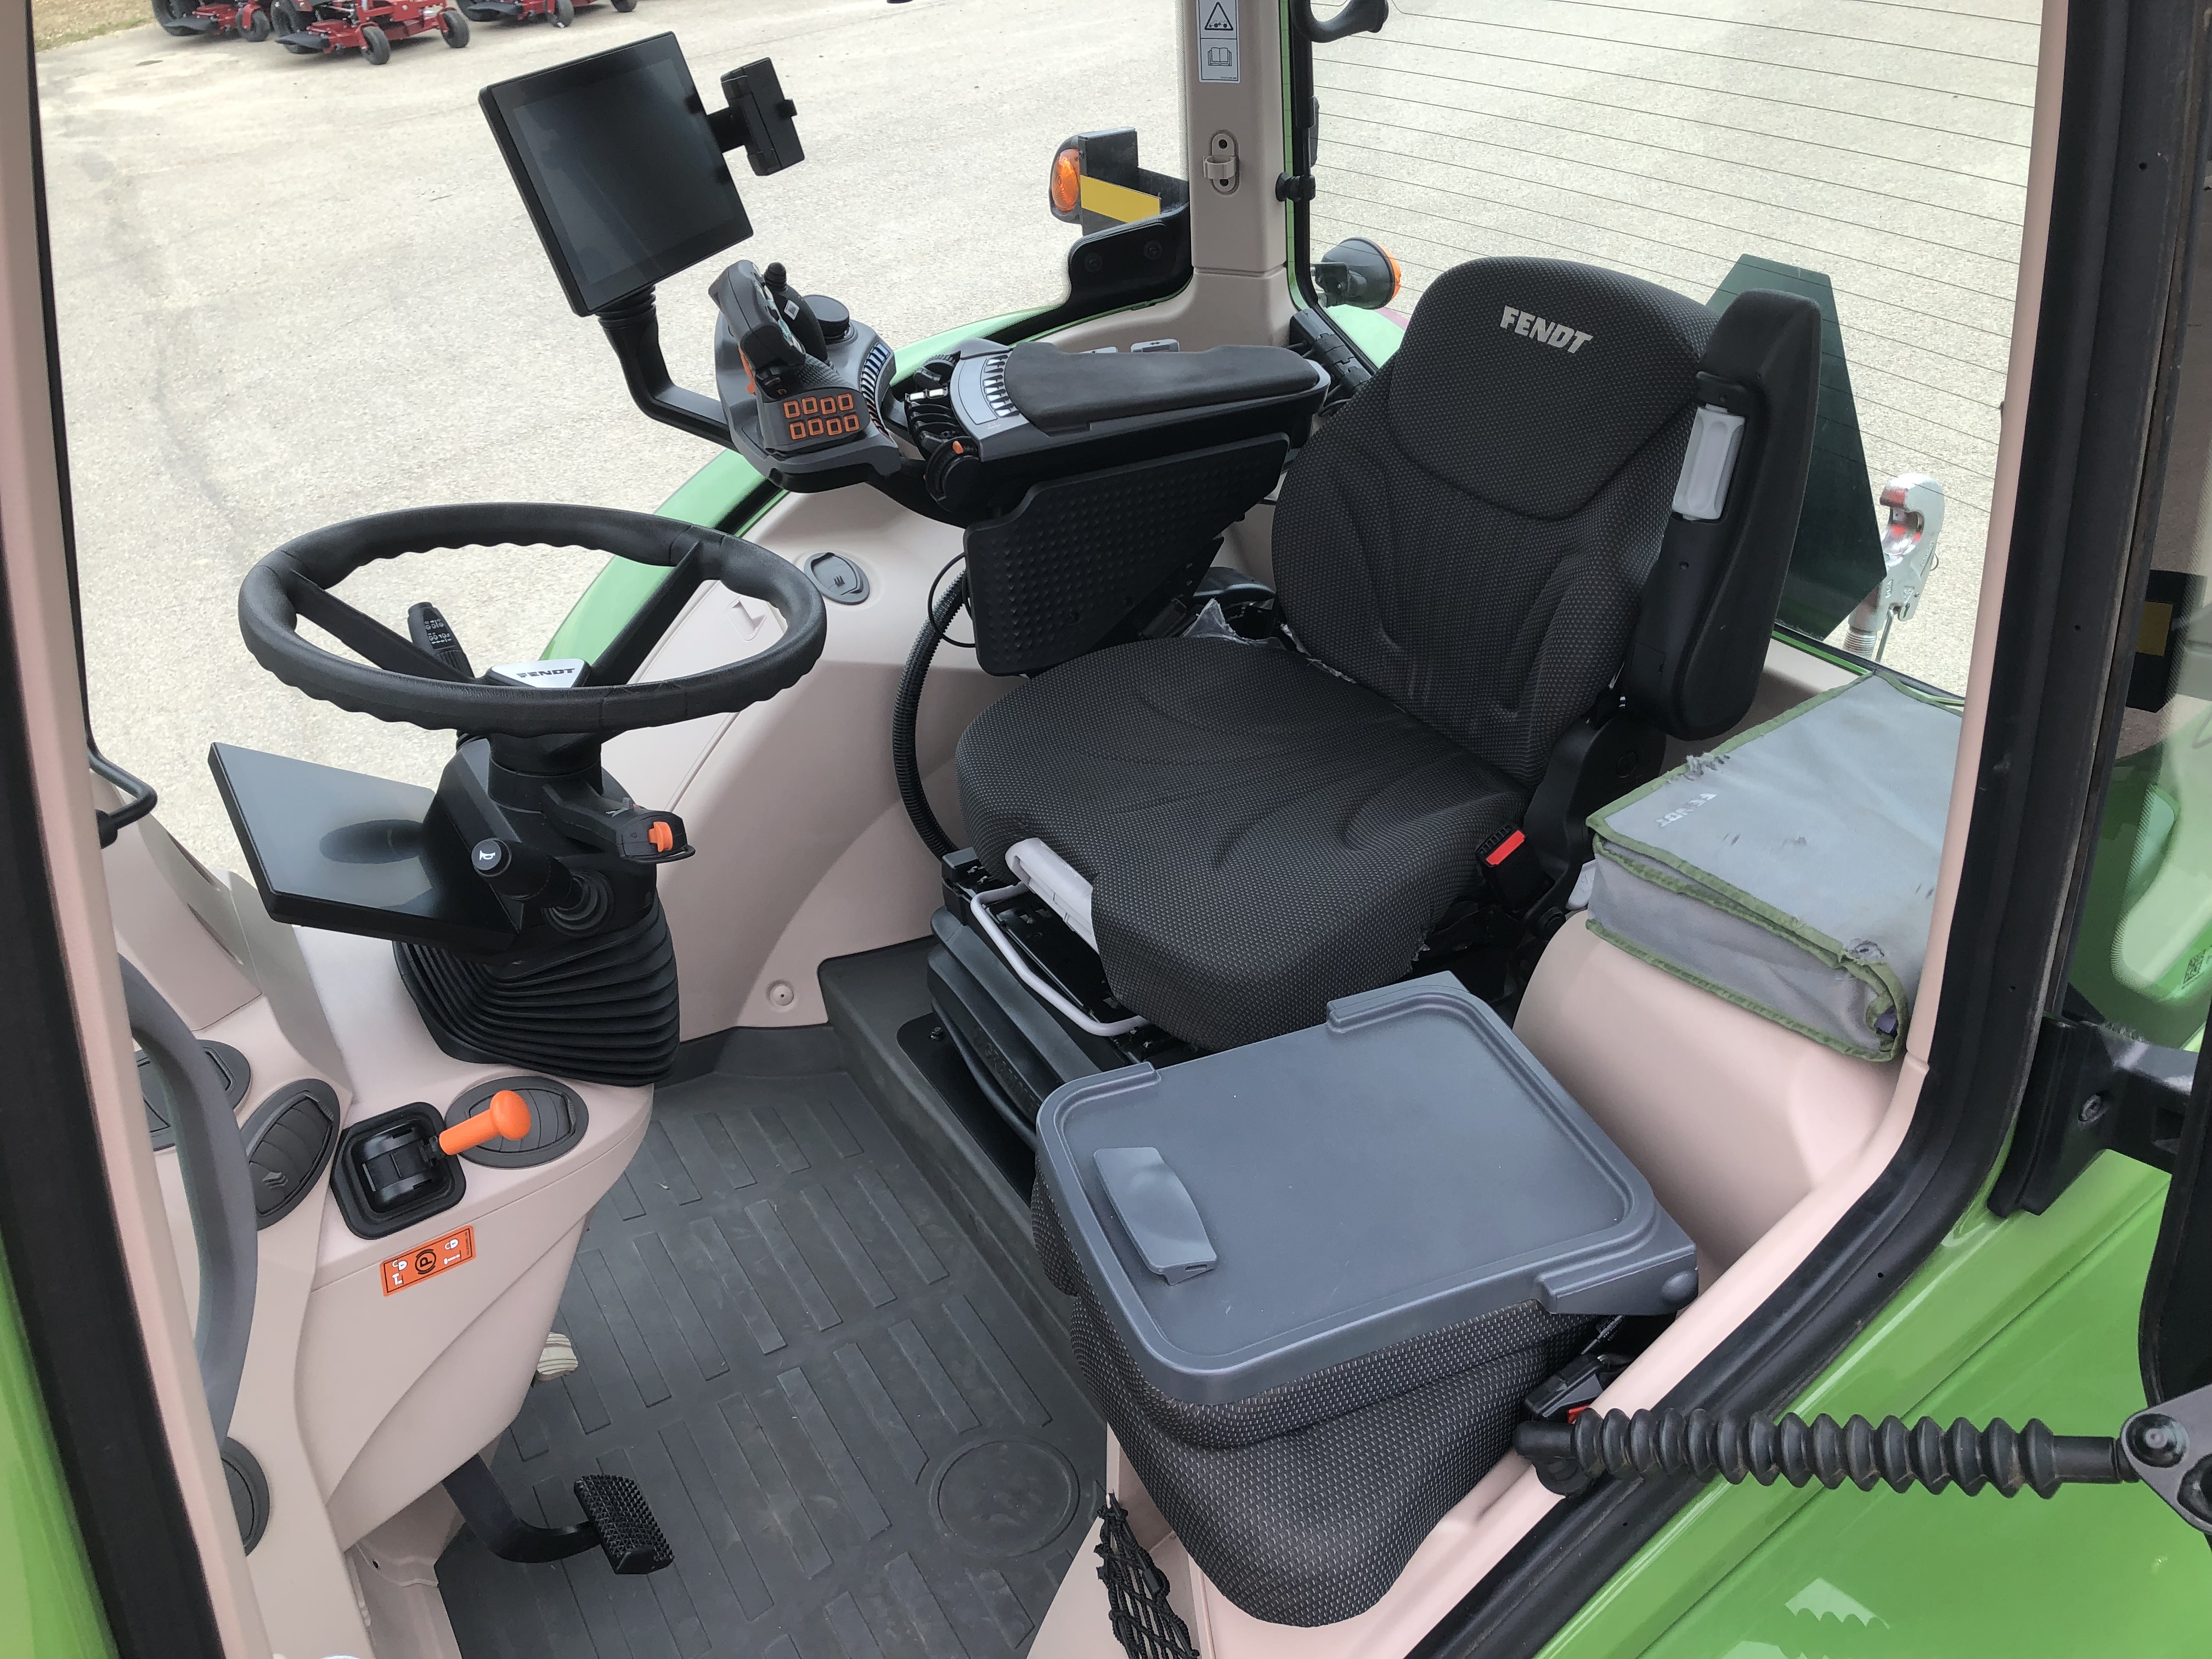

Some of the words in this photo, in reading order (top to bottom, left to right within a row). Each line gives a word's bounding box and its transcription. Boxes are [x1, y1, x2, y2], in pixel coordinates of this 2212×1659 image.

[1499, 304, 1594, 354] FENDT
[516, 668, 575, 678] FENDT
[1656, 793, 1718, 827] FENDT
